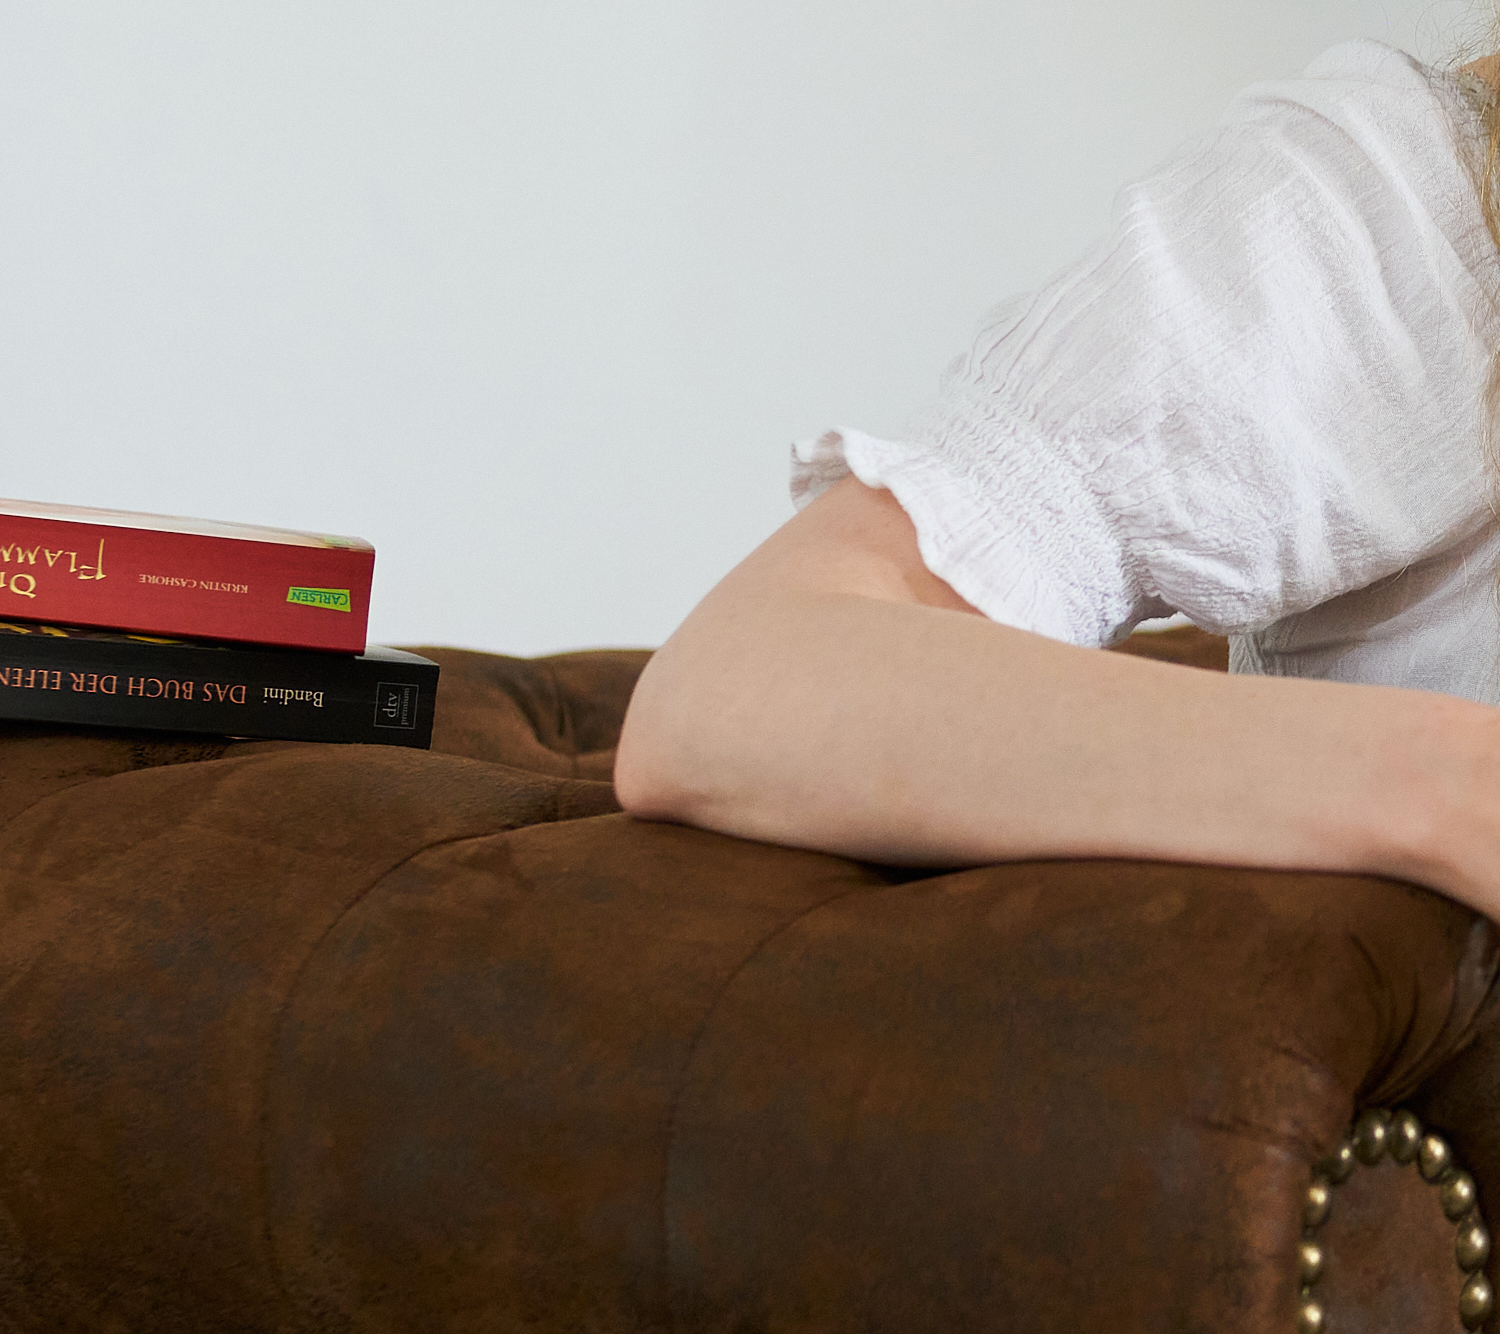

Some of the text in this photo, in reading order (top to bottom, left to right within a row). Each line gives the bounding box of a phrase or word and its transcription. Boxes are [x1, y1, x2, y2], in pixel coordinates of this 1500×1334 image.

[138, 573, 249, 594] KRISTIN CASHORE
[290, 589, 348, 606] CARLSEN
[69, 672, 118, 695] DER
[127, 677, 194, 700] BUCH
[202, 682, 247, 704] DAS
[263, 687, 325, 708] Bandini
[382, 692, 399, 718] dtv
[400, 687, 411, 727] premium
